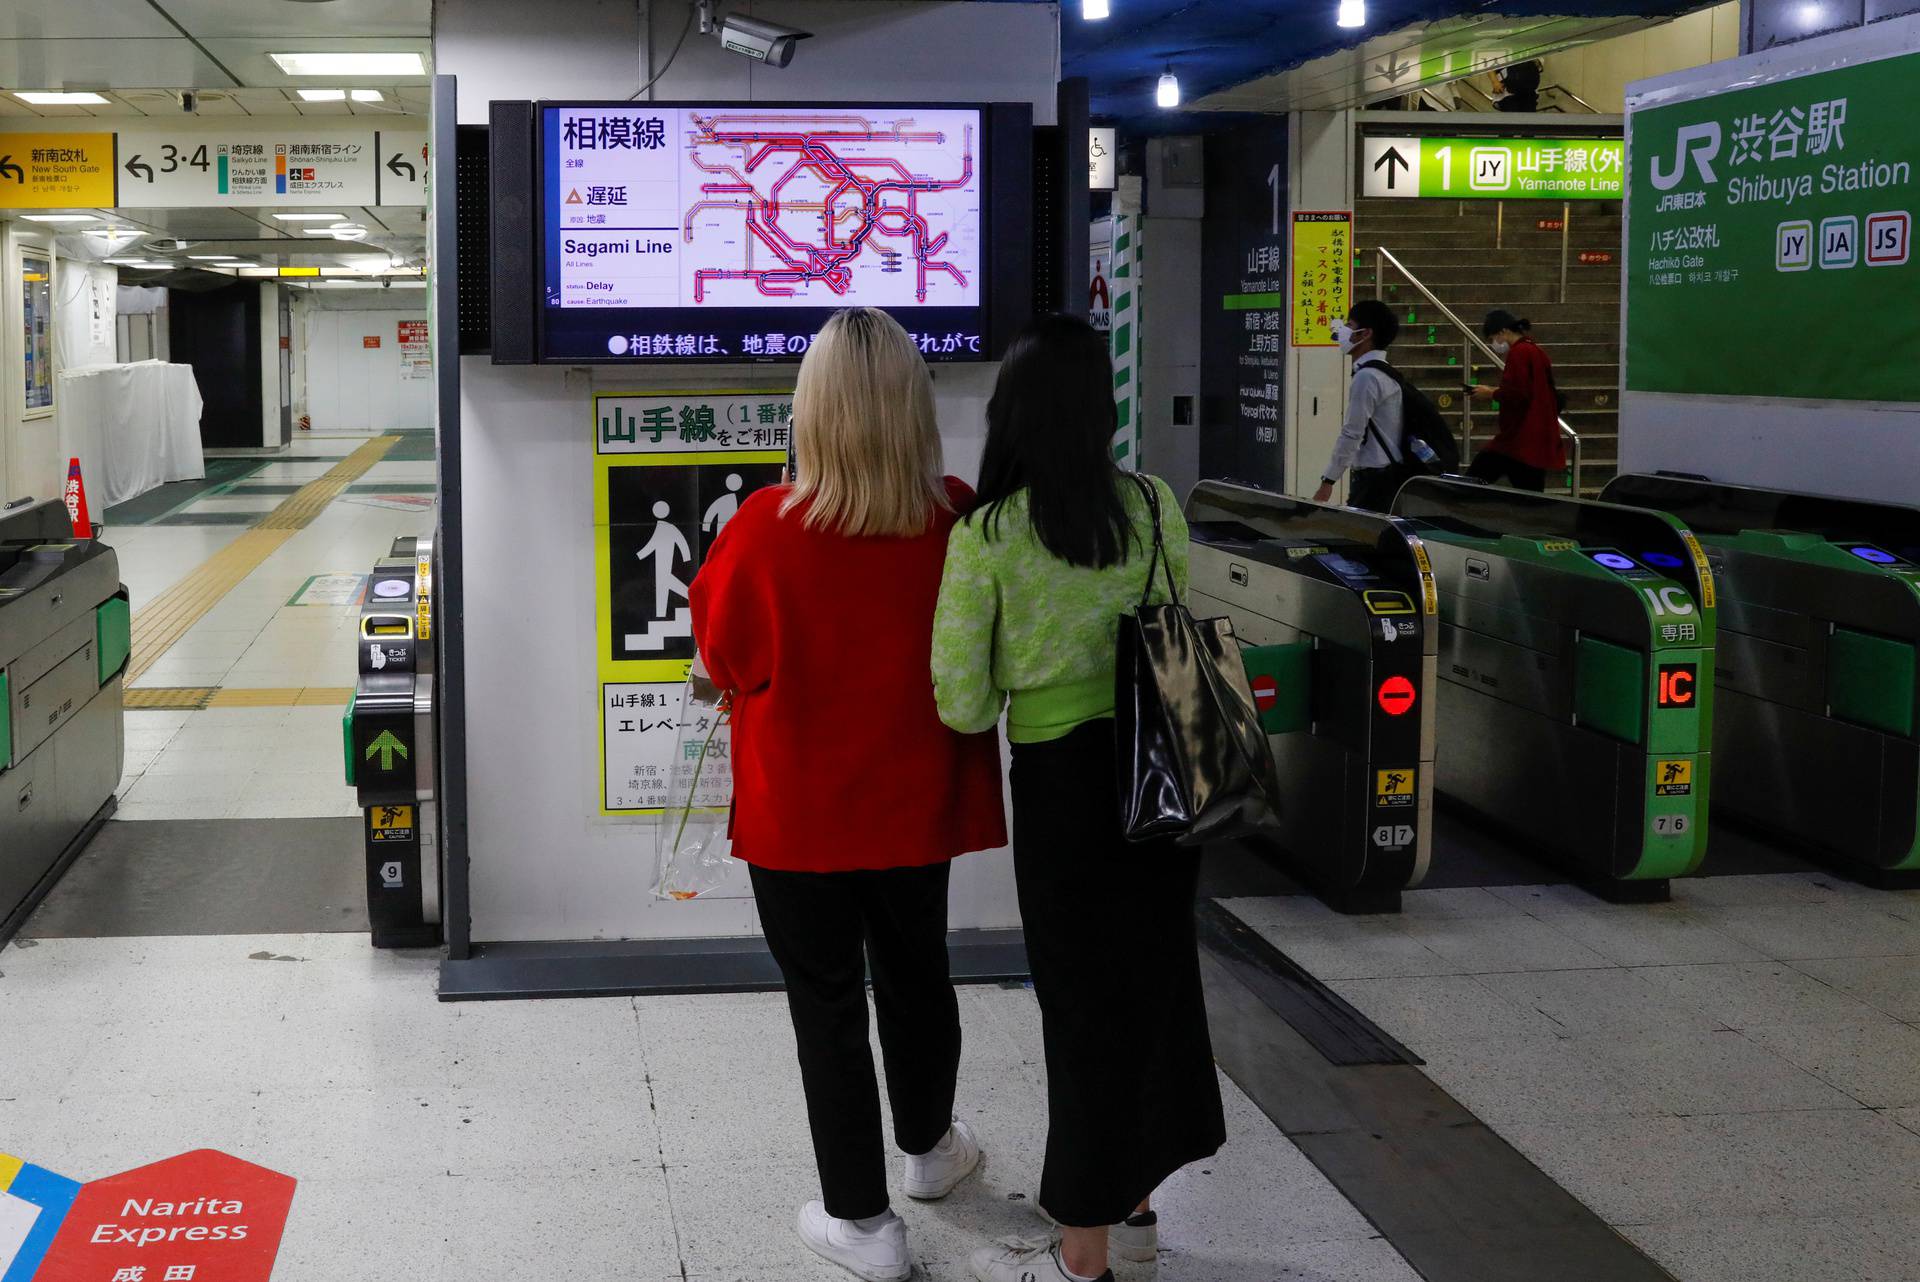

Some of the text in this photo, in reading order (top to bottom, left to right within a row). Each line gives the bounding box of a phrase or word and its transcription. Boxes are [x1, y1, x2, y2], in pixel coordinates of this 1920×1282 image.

[563, 116, 666, 150] 相模線
[1728, 97, 1848, 167] 渋谷駅
[31, 148, 88, 162] 新南改札
[231, 144, 264, 155] 埼京線
[289, 144, 362, 155] 湘南新宿ライン
[1650, 120, 1722, 190] JR
[32, 165, 100, 173] New South Gate
[231, 168, 266, 176] りんかい線
[565, 158, 584, 168] 全線
[1434, 145, 1452, 191] 1
[1478, 160, 1502, 177] JY
[231, 176, 268, 185] 相鉄線方面
[289, 181, 344, 190] 成田エクスプレス
[1517, 177, 1620, 191] Yamanote Line
[1726, 157, 1911, 205] Shibuya Station
[586, 185, 628, 206] 遅延
[1267, 163, 1279, 235] 1
[1655, 190, 1707, 213] JR東日本
[586, 214, 606, 225] 地震
[1650, 223, 1721, 252] ハチ公改札
[1783, 234, 1805, 256] JY
[1826, 231, 1850, 254] JA
[1875, 226, 1898, 250] JS
[564, 239, 673, 257] Sagami Line
[1247, 246, 1280, 274] 山手線
[1682, 254, 1705, 268] Gate
[1331, 229, 1344, 320] 駅構内や電車内では
[586, 281, 614, 291] Delay
[1240, 277, 1280, 293] Yamanote Line
[1316, 246, 1329, 327] マスクの着用
[586, 297, 628, 307] Earthquake
[1245, 311, 1279, 330] 新宿・池袋
[630, 333, 818, 356] 相鉄線は、地震の
[1249, 333, 1279, 352] 上野方面
[602, 404, 717, 444] 山手線
[1643, 586, 1693, 616] IC
[1660, 622, 1696, 642] 専用
[1658, 671, 1692, 704] IC
[1658, 818, 1666, 831] 7
[1674, 818, 1684, 831] 6
[1379, 829, 1388, 842] 8
[1399, 829, 1407, 841] 7
[387, 865, 398, 879] 9
[120, 1197, 244, 1217] Narita
[89, 1222, 249, 1247] Express
[111, 1265, 197, 1282] 成田
